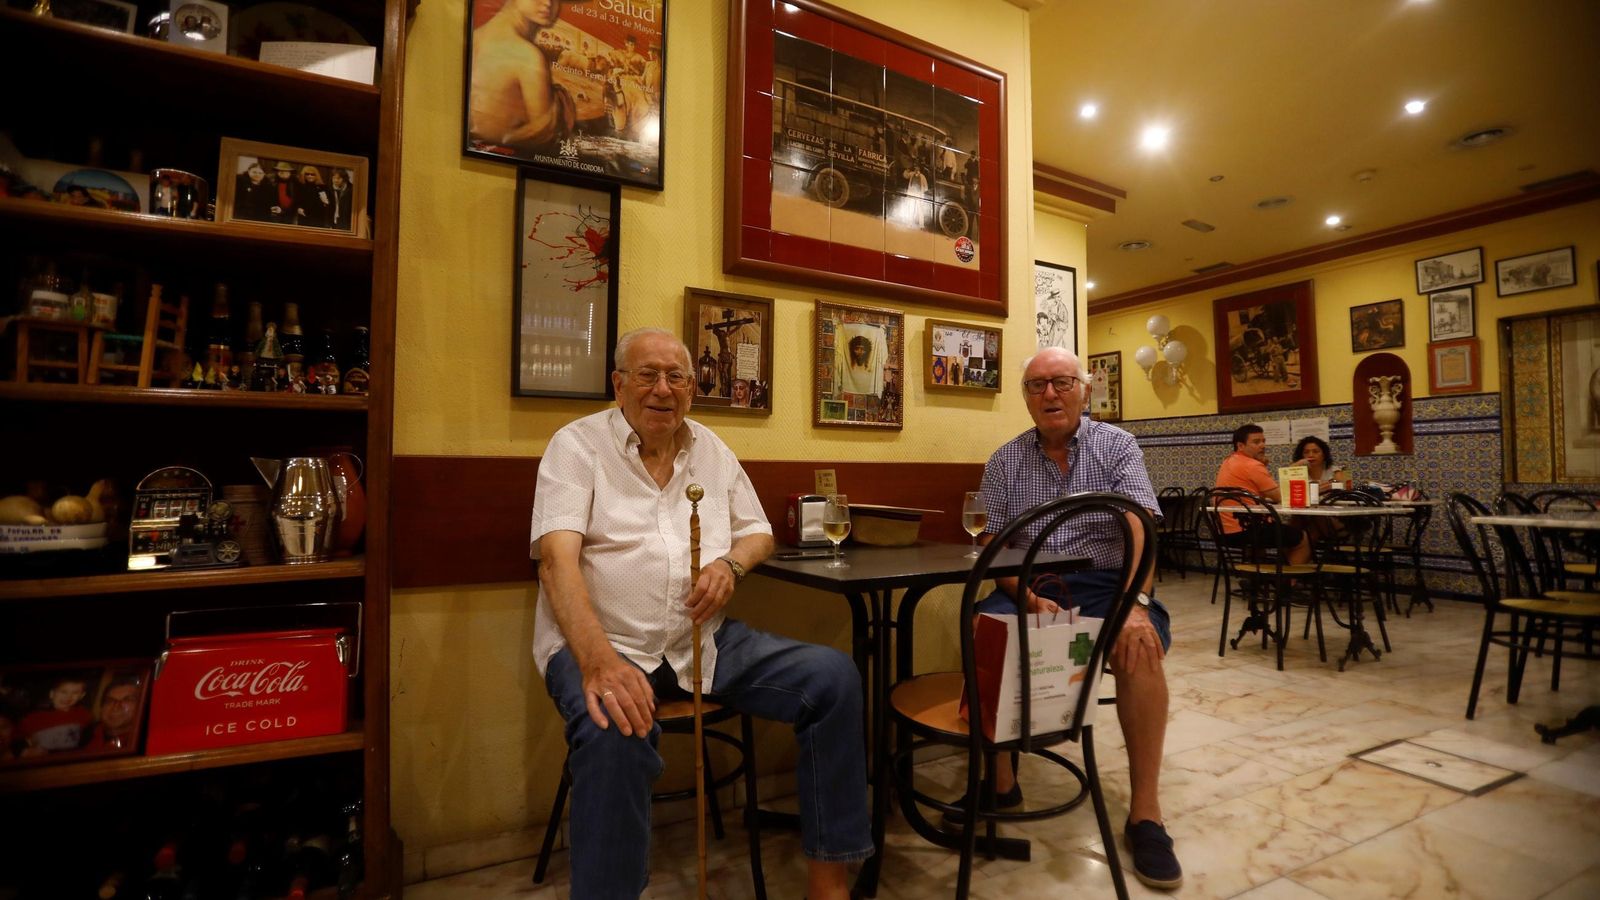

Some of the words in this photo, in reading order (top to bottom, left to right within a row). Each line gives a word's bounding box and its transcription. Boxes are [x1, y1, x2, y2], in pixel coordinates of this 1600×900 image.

[571, 5, 584, 15] del
[586, 8, 597, 18] 23
[600, 13, 607, 21] al
[609, 15, 619, 24] 31
[622, 19, 632, 27] de
[634, 22, 655, 35] Mayo
[599, 0, 655, 23] Salud
[787, 128, 825, 145] CERVEZAS
[533, 154, 573, 168] AYUNTAMIENTO
[573, 161, 580, 169] DE
[580, 162, 605, 174] CORDOBA
[827, 149, 855, 163] SEVILLA
[230, 659, 265, 667] DRINK
[194, 660, 311, 700] Coca-Cola
[224, 700, 254, 709] TRADE
[255, 698, 281, 706] MARK
[205, 722, 238, 736] ICE
[245, 716, 297, 731] COLD
